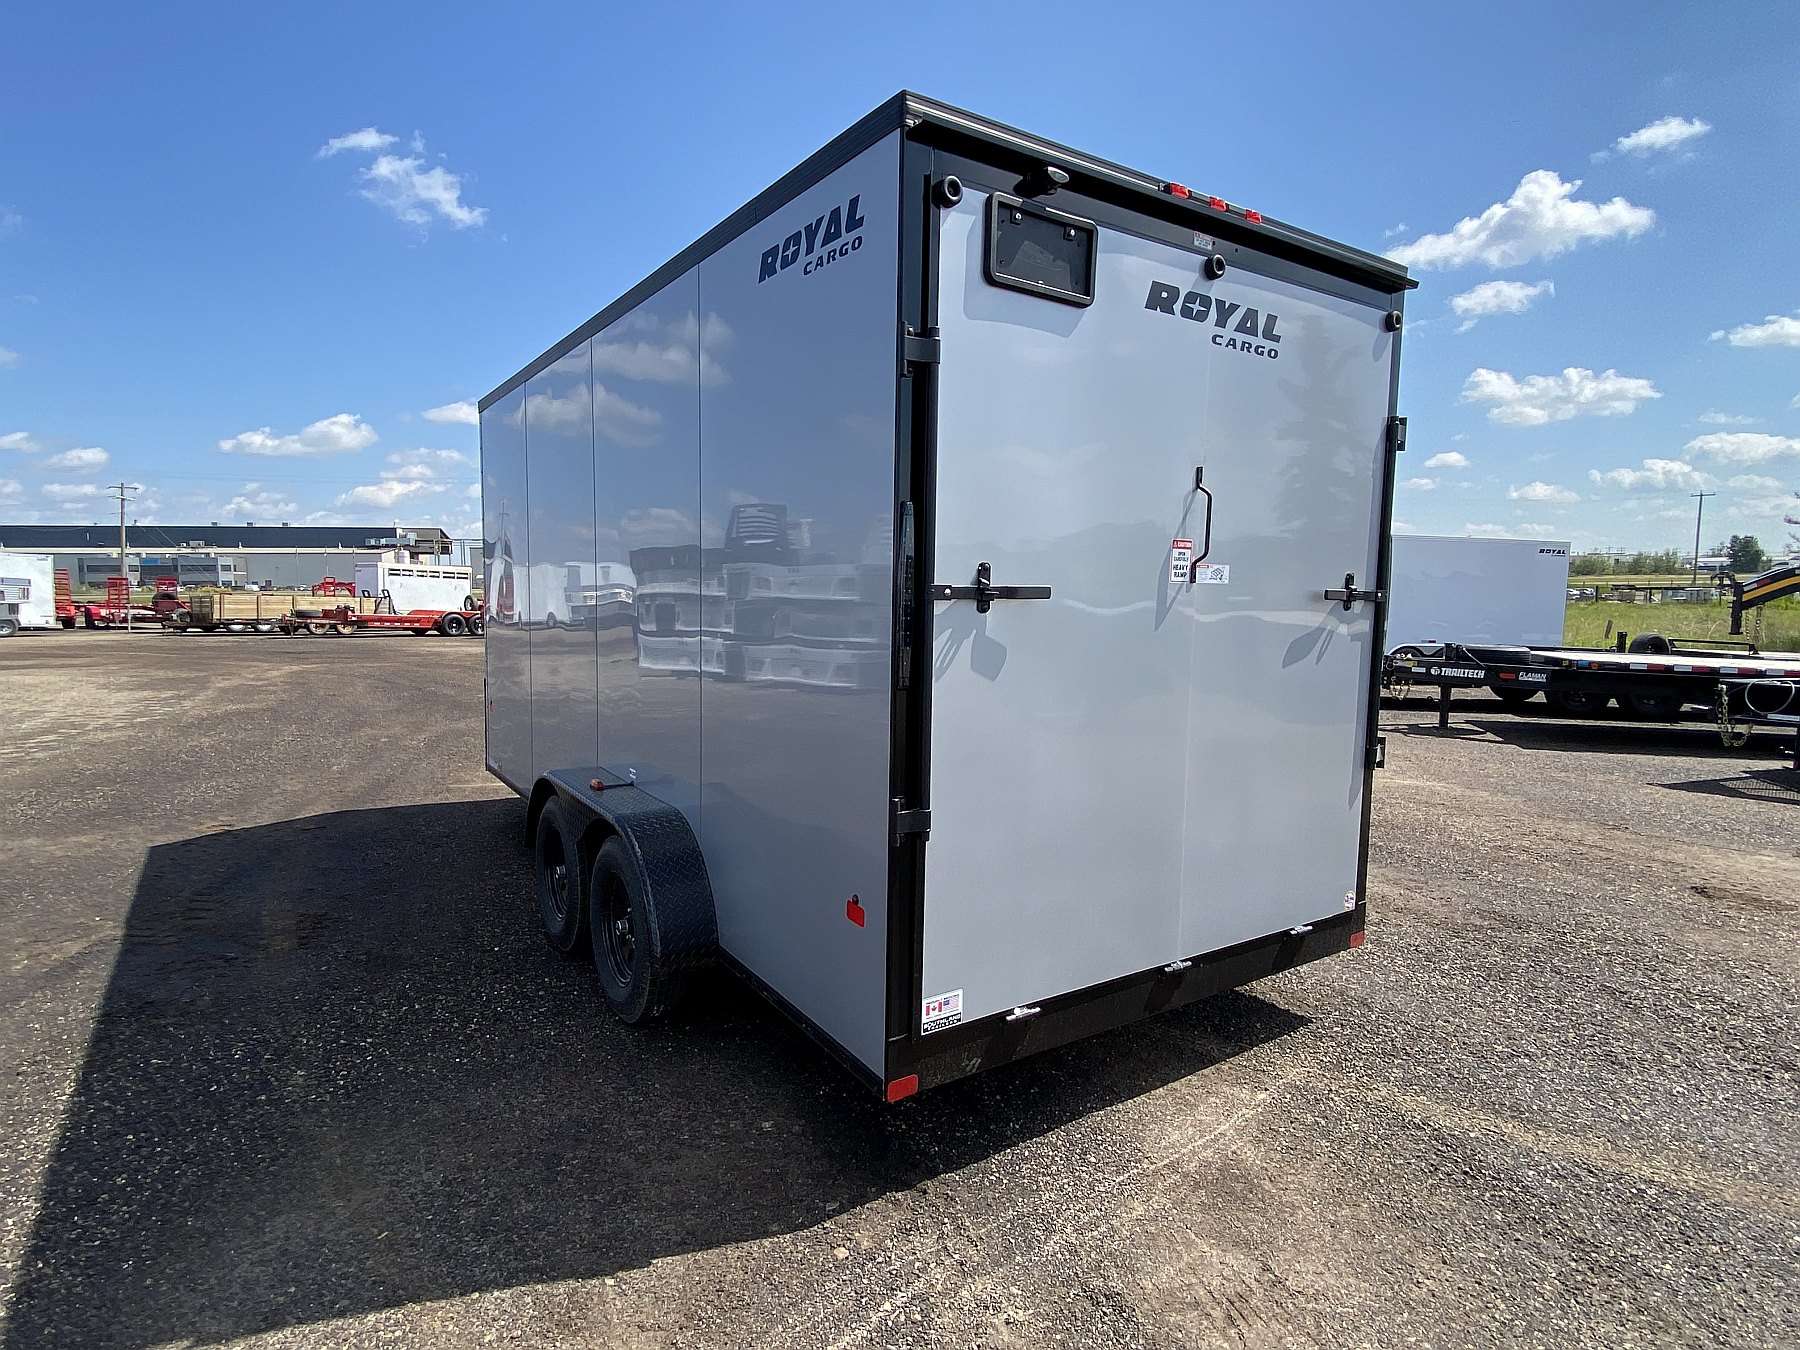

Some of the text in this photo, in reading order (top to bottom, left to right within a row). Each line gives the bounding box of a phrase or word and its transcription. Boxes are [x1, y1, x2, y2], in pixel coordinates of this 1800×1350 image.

[759, 194, 865, 284] ROYAL
[803, 236, 863, 276] CARGO
[1144, 280, 1281, 343] ROYAL
[1211, 334, 1279, 360] CARGO
[1173, 571, 1188, 579] RAMP
[1441, 667, 1485, 679] TRAILTECH
[923, 1014, 961, 1030] SOUTHLAND
